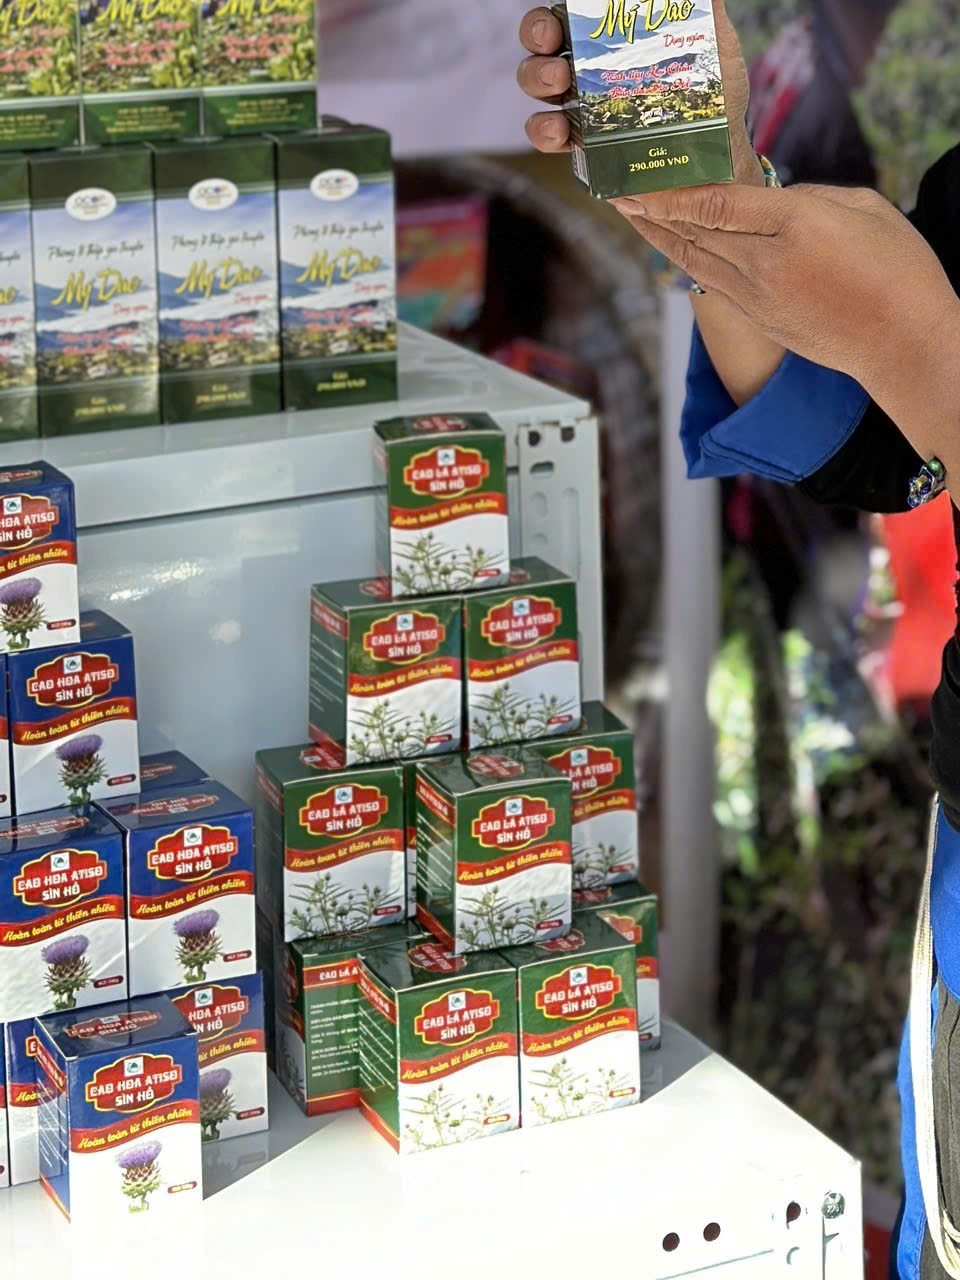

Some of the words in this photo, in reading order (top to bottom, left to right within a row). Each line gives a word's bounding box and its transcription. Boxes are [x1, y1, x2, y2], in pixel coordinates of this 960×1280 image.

[648, 147, 668, 157] Giá:
[629, 159, 666, 172] 290.000
[24, 511, 55, 526] ATISO
[371, 635, 393, 646] CAO
[31, 679, 54, 692] CAO
[56, 675, 80, 687] HOA
[307, 808, 330, 821] CAO
[332, 805, 347, 817] LÁ
[480, 819, 501, 833] CAO
[503, 815, 516, 829] LÁ
[151, 851, 174, 865] CAO
[177, 846, 200, 860] HOA
[17, 877, 41, 891] CAO
[44, 873, 68, 886] HOA
[319, 970, 337, 981] CAO
[544, 990, 566, 1004] CAO
[568, 986, 581, 999] LÁ
[422, 1017, 444, 1030] CAO
[446, 1011, 460, 1025] LÁ
[89, 1082, 114, 1098] CAO
[116, 1077, 142, 1093] HOA
